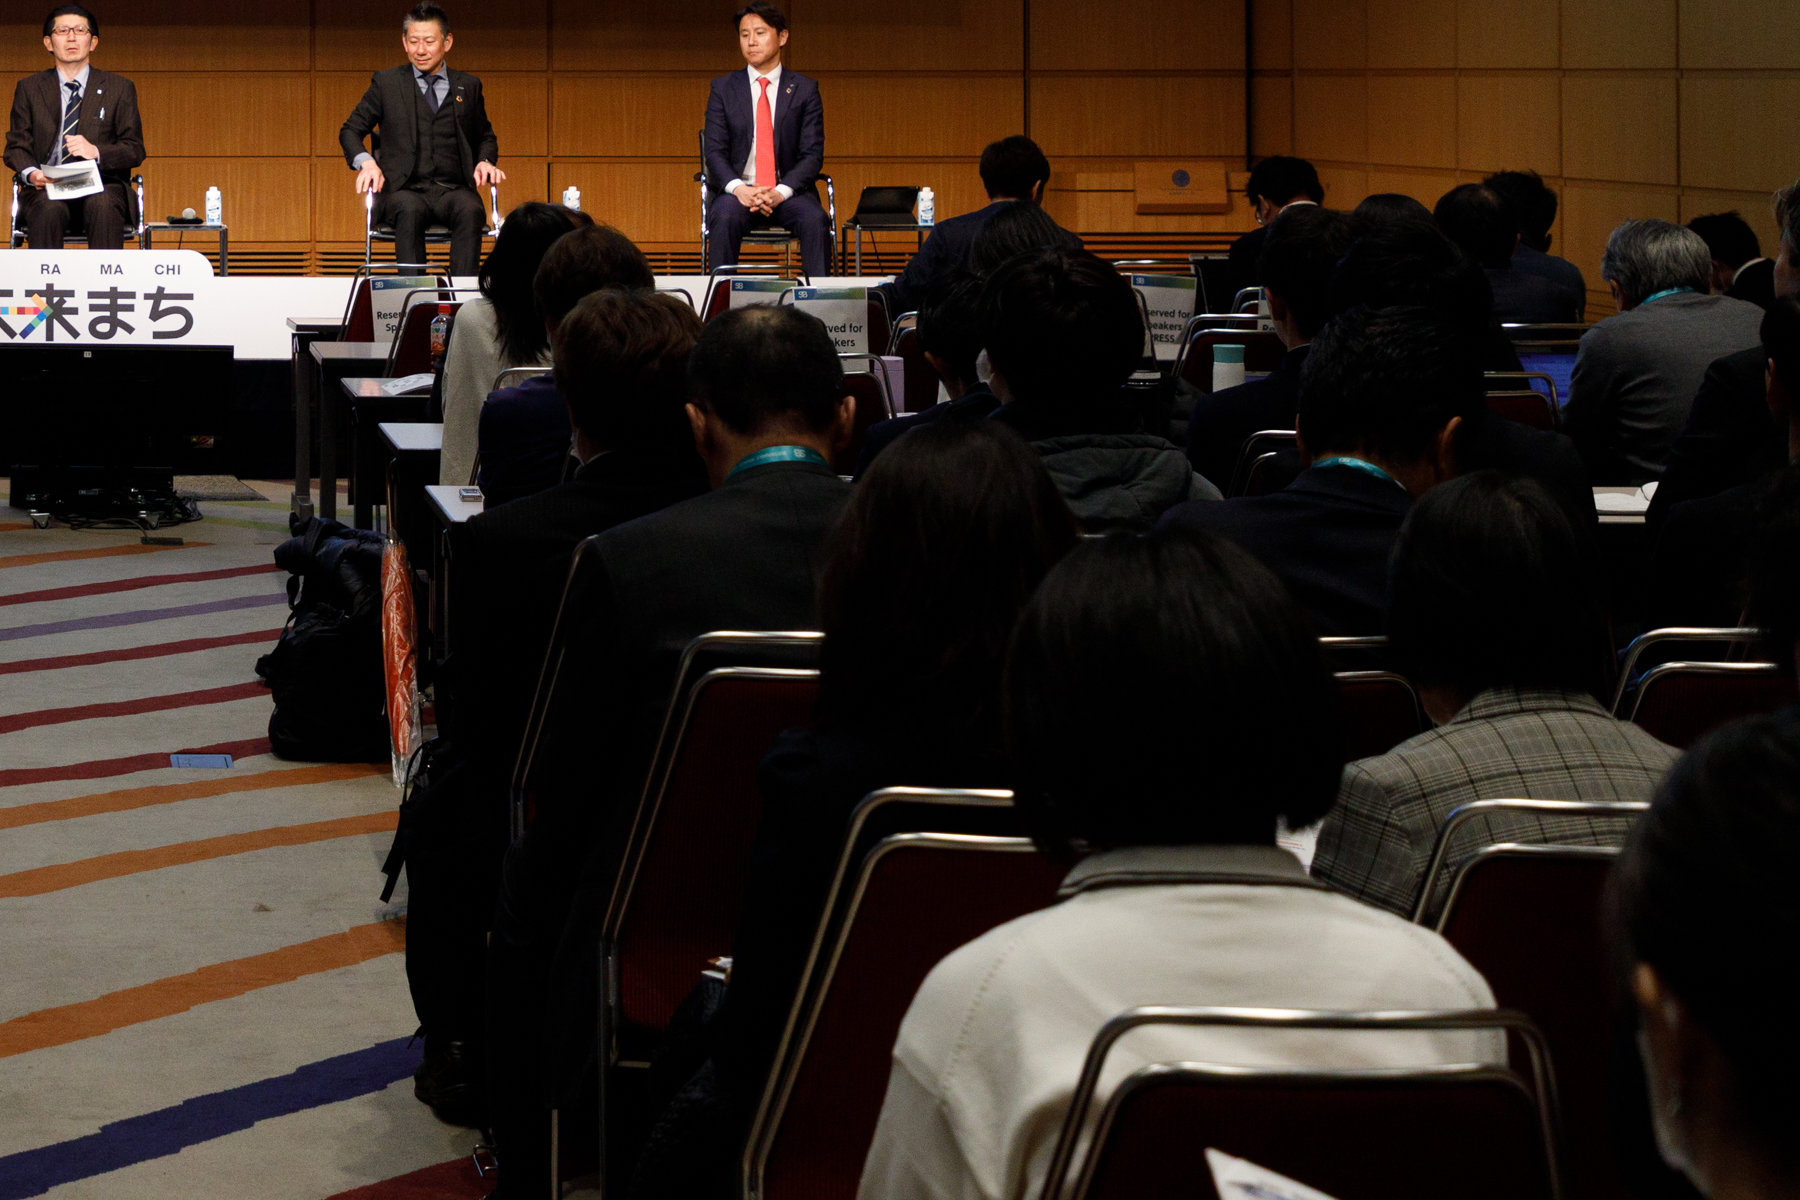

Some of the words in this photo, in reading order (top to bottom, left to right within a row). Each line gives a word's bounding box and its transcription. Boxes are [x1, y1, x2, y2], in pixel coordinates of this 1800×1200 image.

[40, 263, 61, 275] RA
[100, 264, 124, 275] MA
[154, 264, 181, 276] CHI
[849, 323, 863, 333] for
